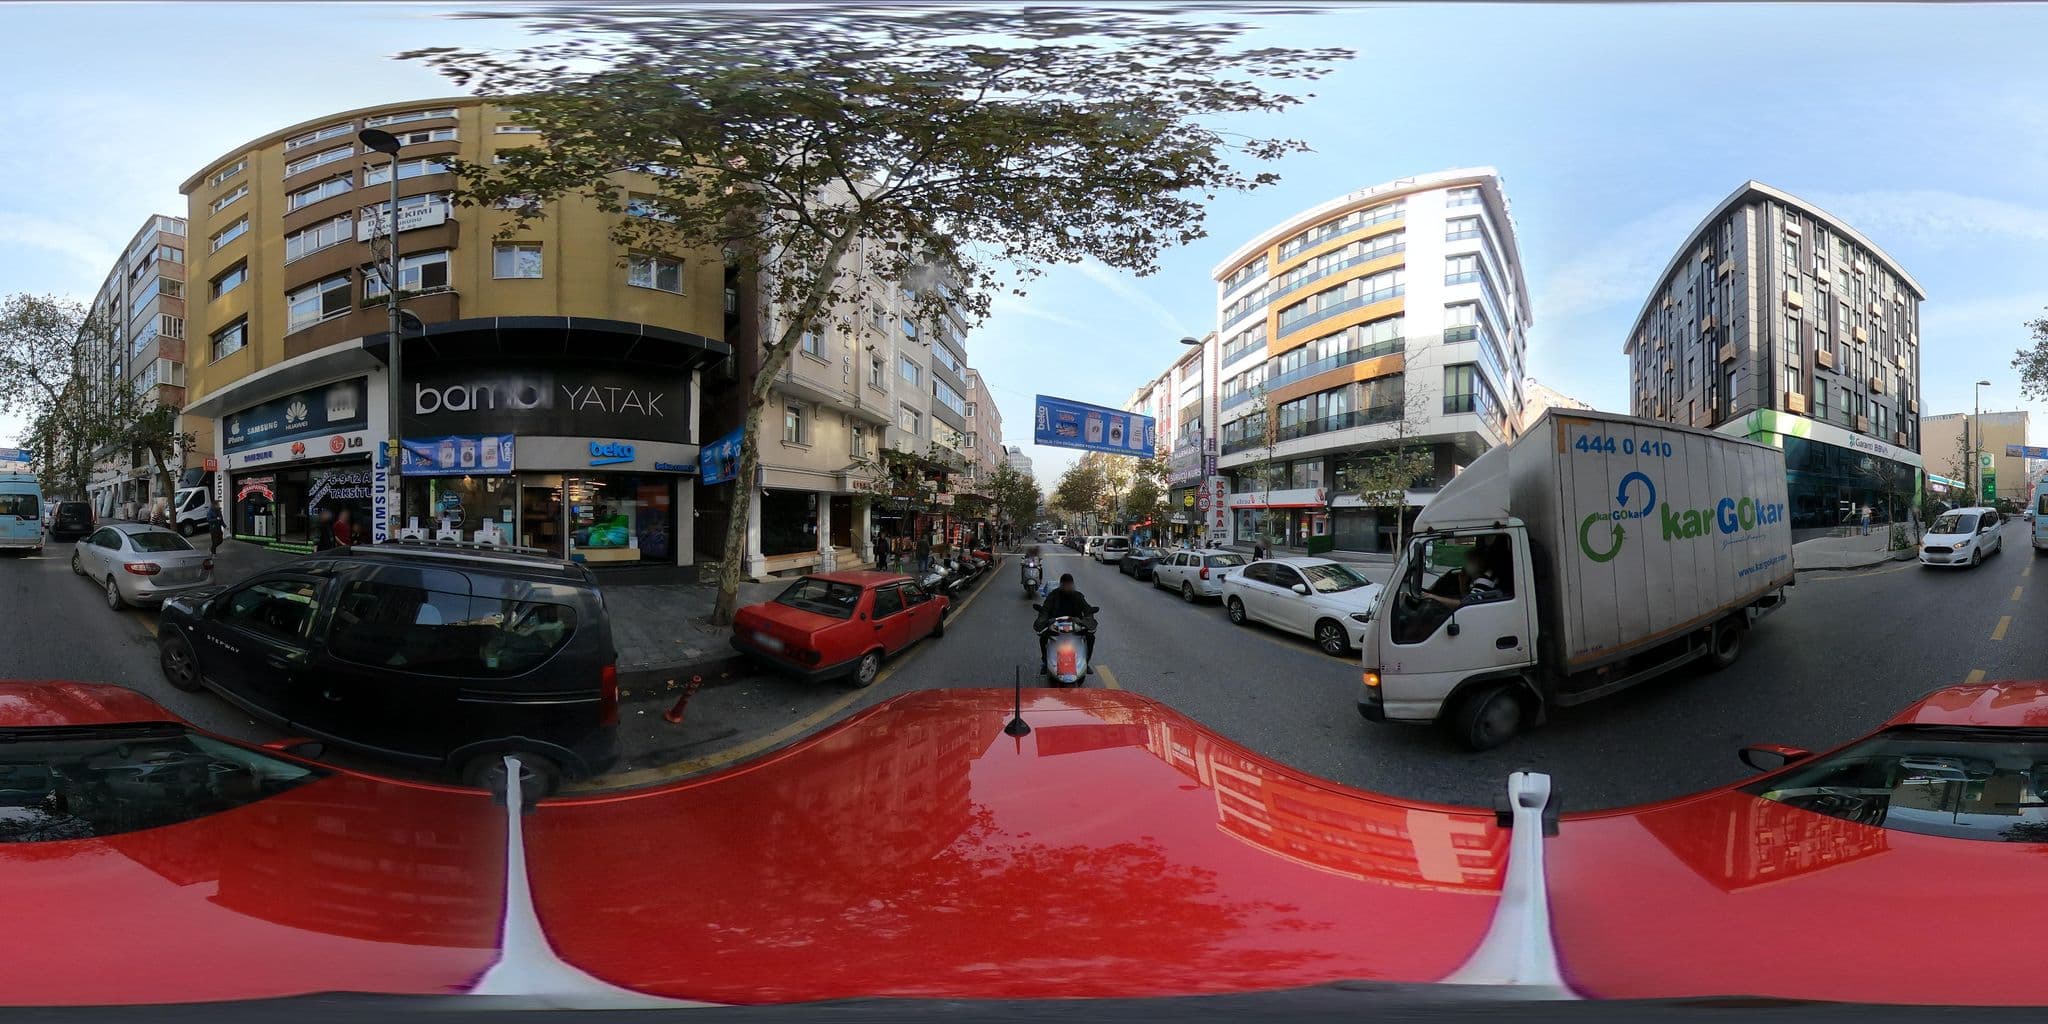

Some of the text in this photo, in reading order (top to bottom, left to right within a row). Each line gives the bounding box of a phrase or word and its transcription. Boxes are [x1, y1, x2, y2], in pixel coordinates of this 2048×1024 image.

[561, 384, 664, 417] YATAK
[247, 421, 278, 435] SAMSUNG
[286, 421, 308, 430] HUAWEI
[228, 435, 244, 444] iPhone
[348, 436, 363, 448] LG
[1575, 434, 1672, 458] 444 0 410
[590, 441, 635, 458] beko
[1661, 497, 1784, 541] karGOkar
[207, 634, 240, 653] STEPWAY
